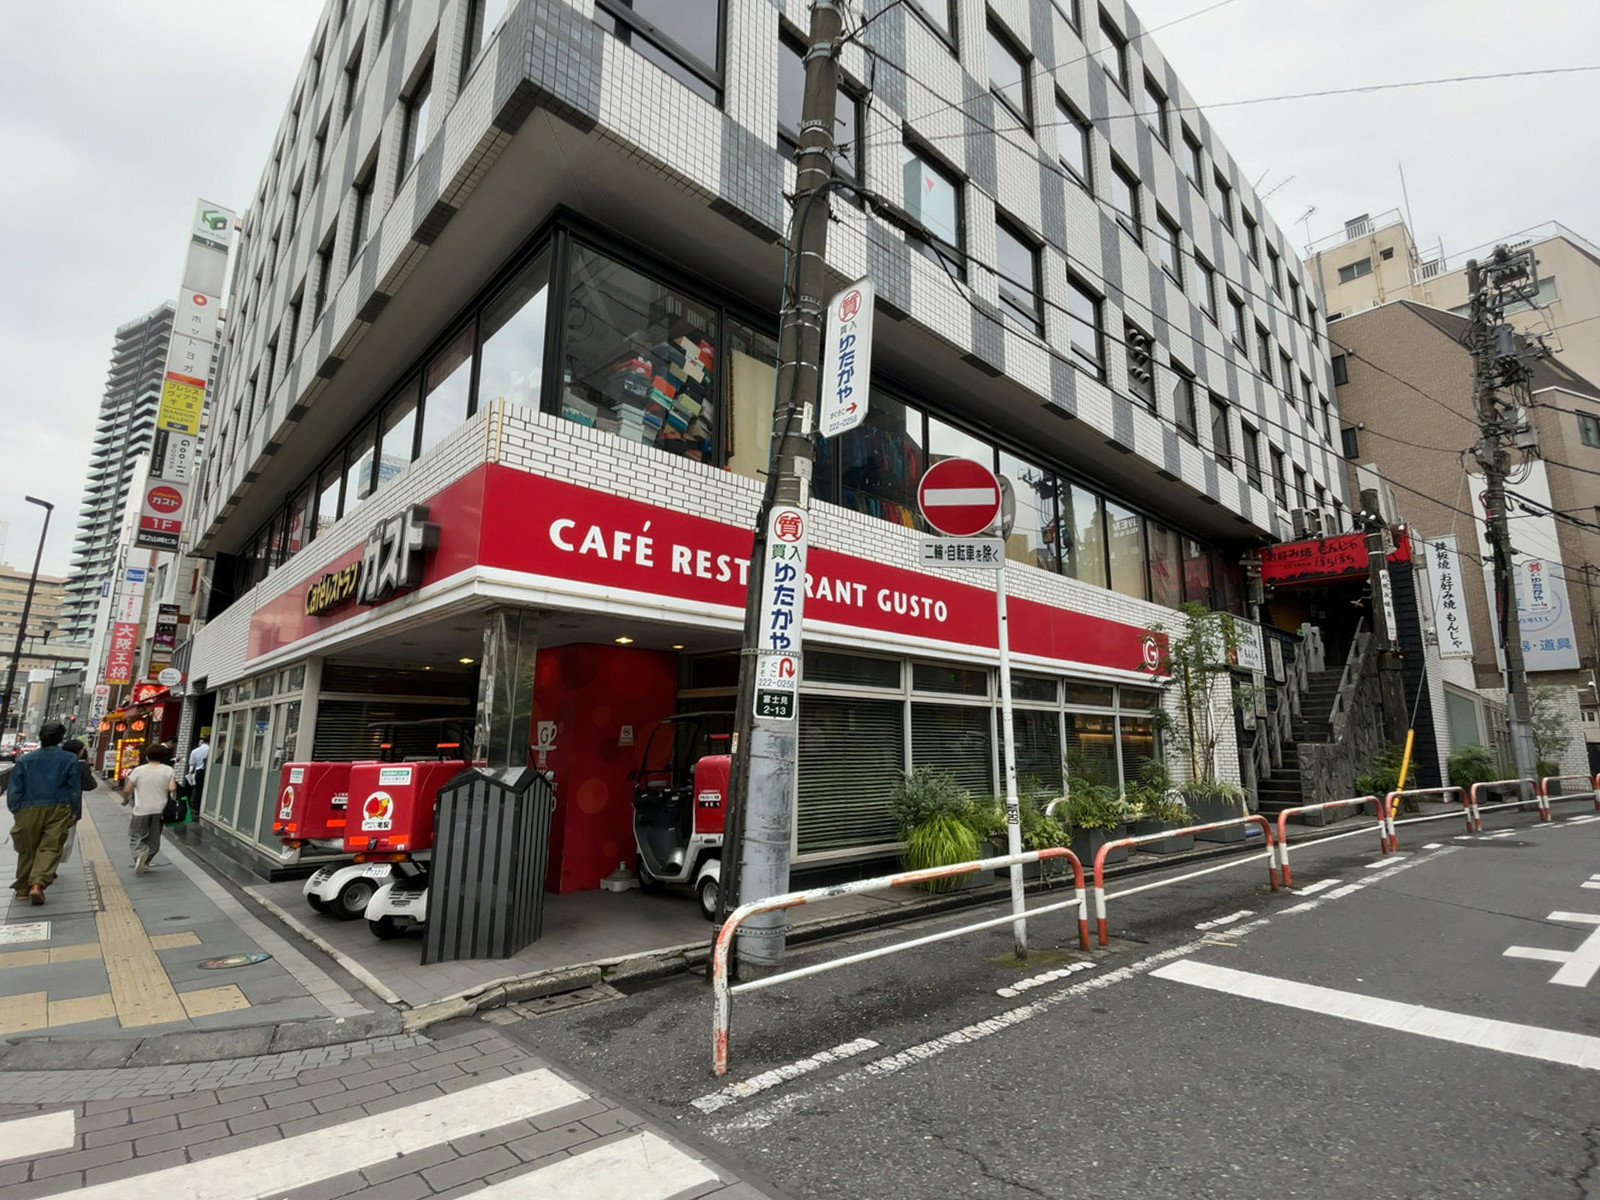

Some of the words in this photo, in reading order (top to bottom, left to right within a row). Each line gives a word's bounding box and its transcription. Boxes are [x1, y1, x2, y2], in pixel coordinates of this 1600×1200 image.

[183, 315, 202, 373] ホットヨガ
[837, 334, 857, 404] ゆたかや
[152, 496, 179, 507] ガスト
[152, 518, 173, 530] 1F
[778, 514, 801, 540] 質
[357, 503, 438, 606] ガスト
[771, 544, 801, 563] 買入
[924, 543, 999, 563] 二輪・自転車を除く
[549, 519, 655, 568] CAFÉ
[671, 543, 869, 609] RESTRANT
[877, 588, 948, 623] GUSTO
[1440, 573, 1457, 610] お好み焼
[1531, 577, 1544, 602] ゆたかや
[769, 562, 797, 651] ゆたかや
[1446, 612, 1463, 648] もんじゃ
[109, 624, 135, 680] 大阪王将
[758, 678, 795, 689] 222-0258
[762, 694, 788, 706] 富士見
[763, 705, 787, 716] 2-13
